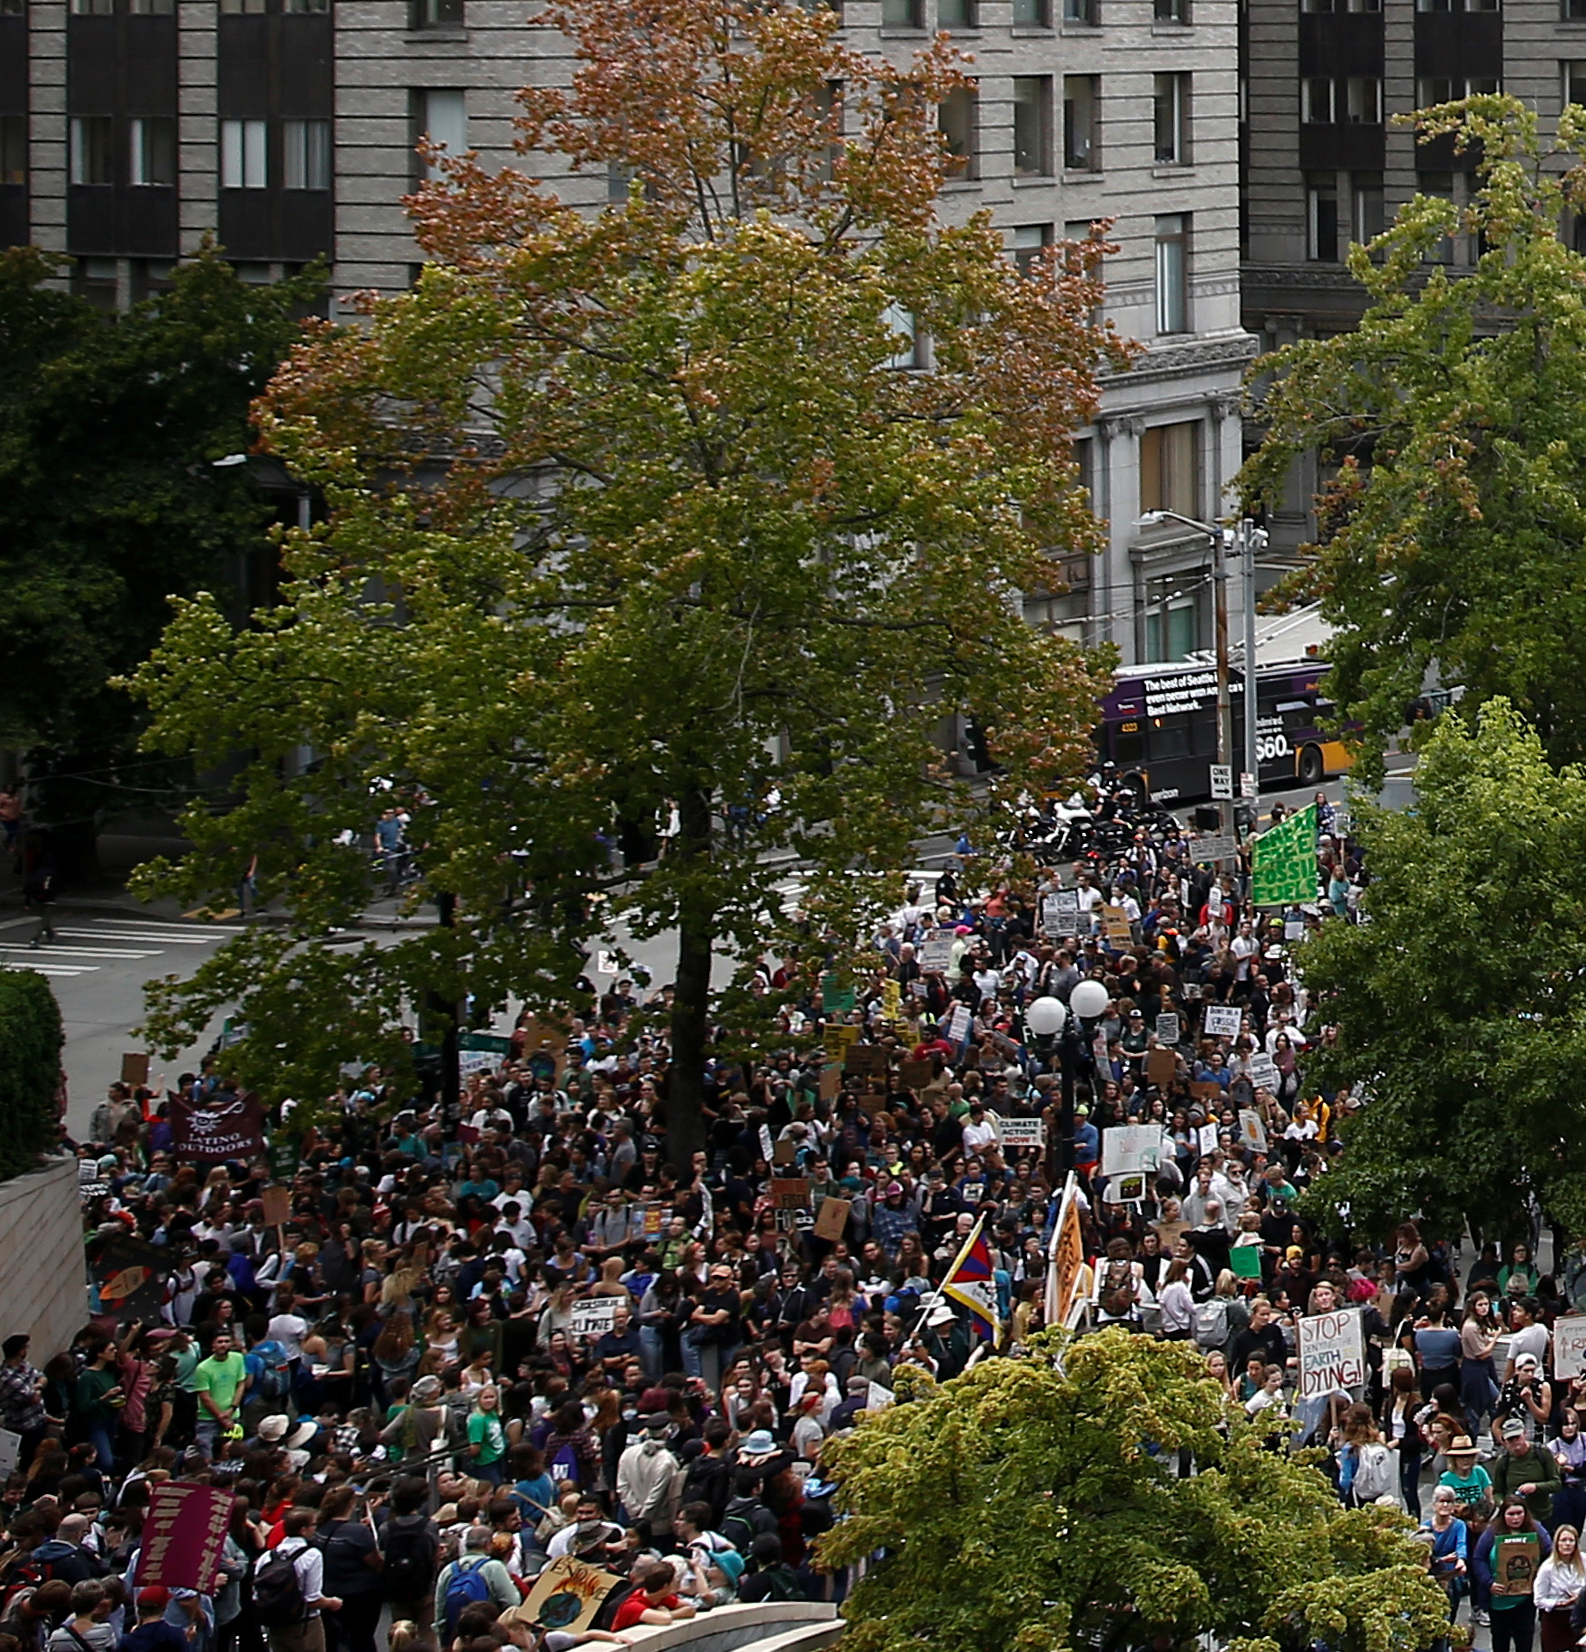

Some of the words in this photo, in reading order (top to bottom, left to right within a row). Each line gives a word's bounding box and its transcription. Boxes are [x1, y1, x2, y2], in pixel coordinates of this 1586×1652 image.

[1144, 679, 1159, 691] The
[1160, 678, 1179, 690] best
[1179, 676, 1187, 687] of
[1187, 672, 1213, 687] Seattle
[1212, 768, 1229, 776] ONE
[1257, 832, 1312, 867] FREE
[1253, 858, 1317, 886] FOSSIL
[1254, 877, 1318, 904] FUELS
[1000, 1120, 1039, 1128] CLIMATE
[1002, 1128, 1036, 1136] ACTION
[179, 1138, 253, 1154] OUTDOORS
[189, 1132, 241, 1146] LATINO
[1302, 1311, 1351, 1342] STOP
[1303, 1350, 1340, 1370] EARTH
[1303, 1359, 1363, 1397] DYING!
